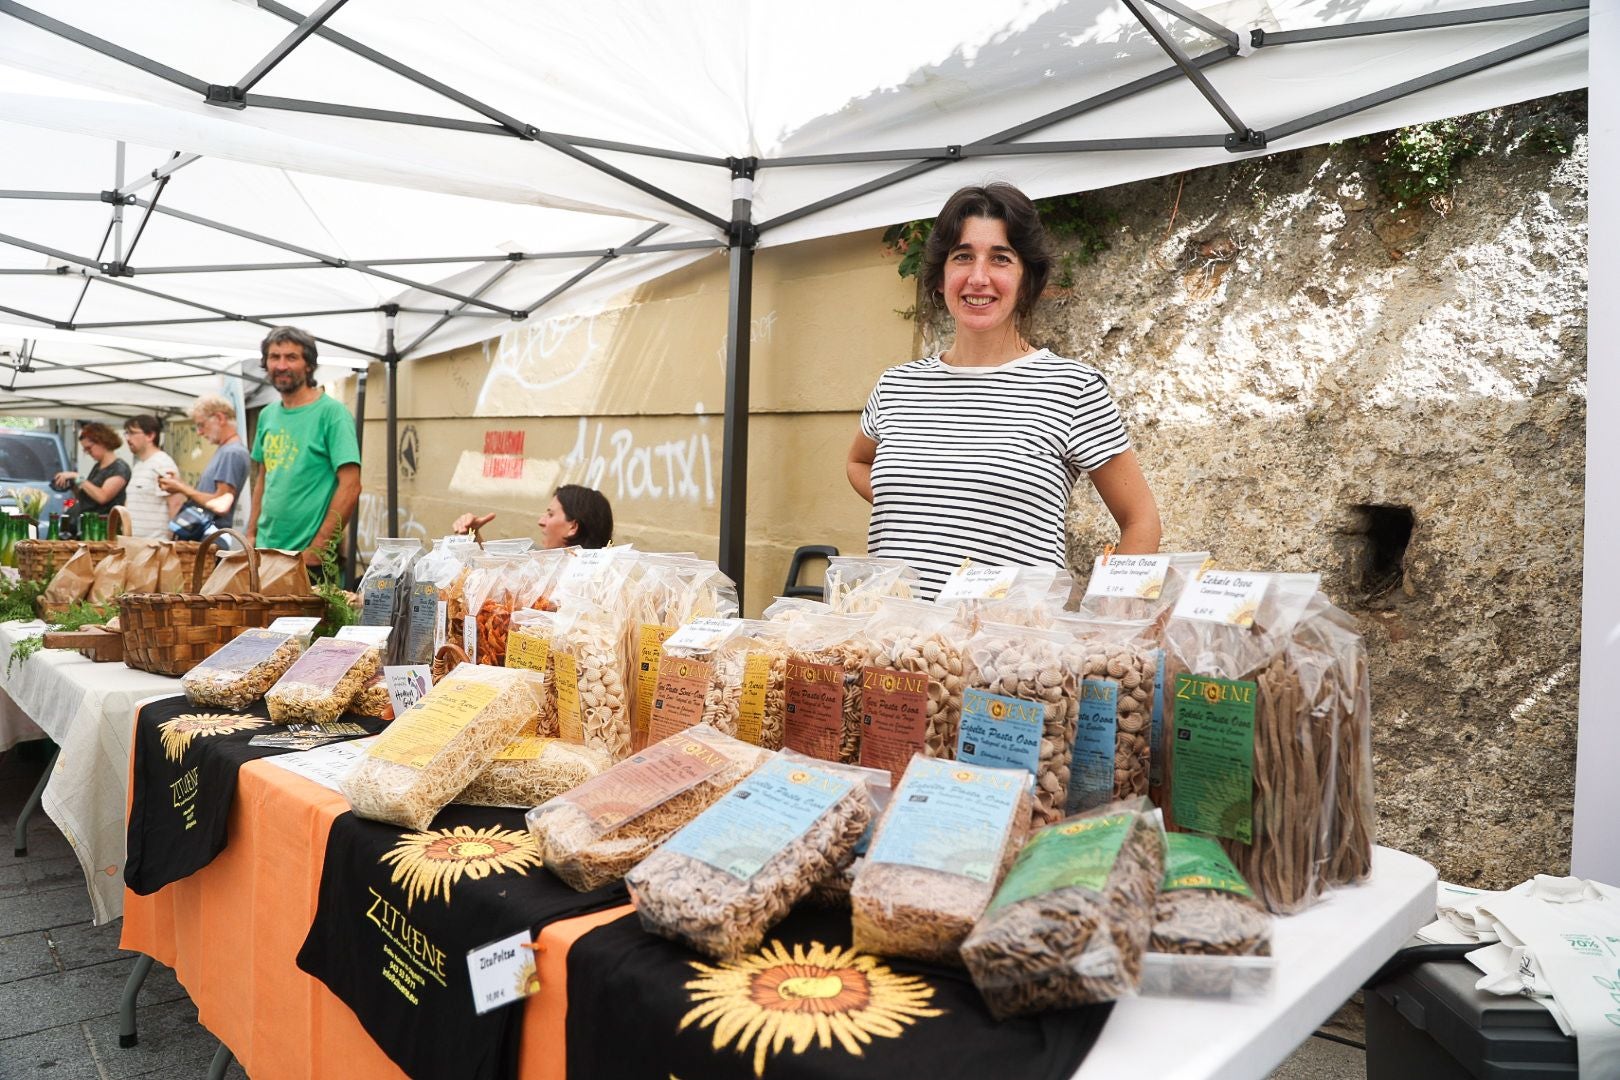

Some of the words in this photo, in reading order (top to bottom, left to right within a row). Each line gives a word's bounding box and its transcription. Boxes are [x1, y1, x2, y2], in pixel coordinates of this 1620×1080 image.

[1109, 557, 1136, 568] Espelta
[1138, 558, 1157, 567] Osoa
[1202, 574, 1230, 586] Zekale
[1234, 576, 1254, 589] Osoa
[1091, 712, 1114, 725] Osoa
[960, 719, 987, 737] Espelta
[987, 727, 1014, 745] Pasta
[1015, 733, 1039, 748] Osoa
[366, 886, 447, 978] ZITUENE
[480, 949, 515, 970] ZituPoltsa
